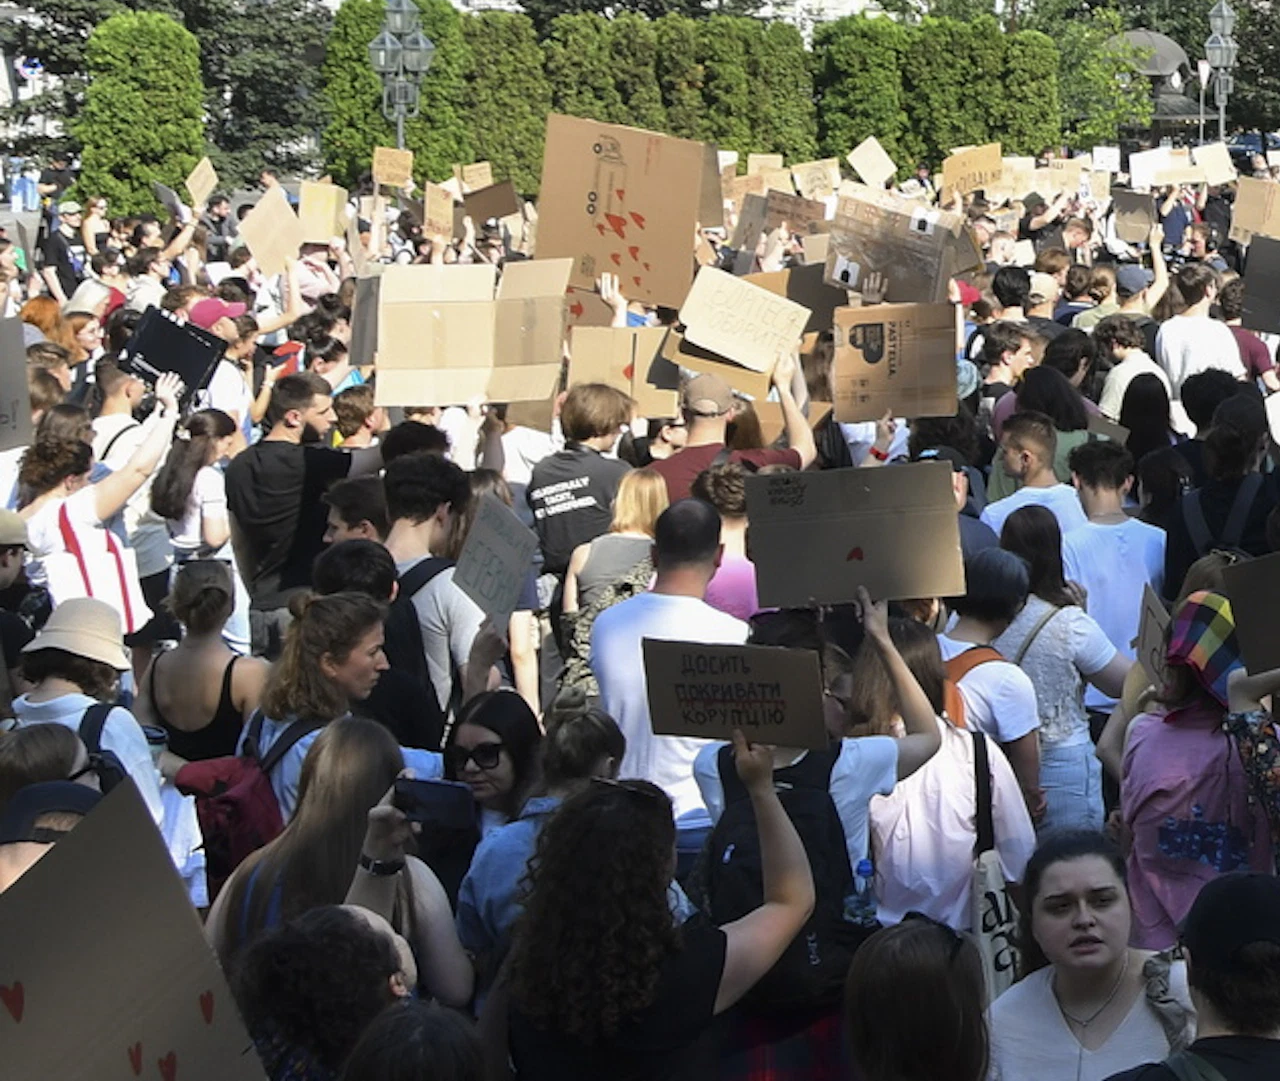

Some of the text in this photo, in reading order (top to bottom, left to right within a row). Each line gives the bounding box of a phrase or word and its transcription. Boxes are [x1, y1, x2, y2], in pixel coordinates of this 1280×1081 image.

[682, 653, 751, 677] ДОСИТЬ
[674, 681, 782, 700] ПОКРИВАТИ
[682, 708, 785, 728] КОРУПЦІЮ
